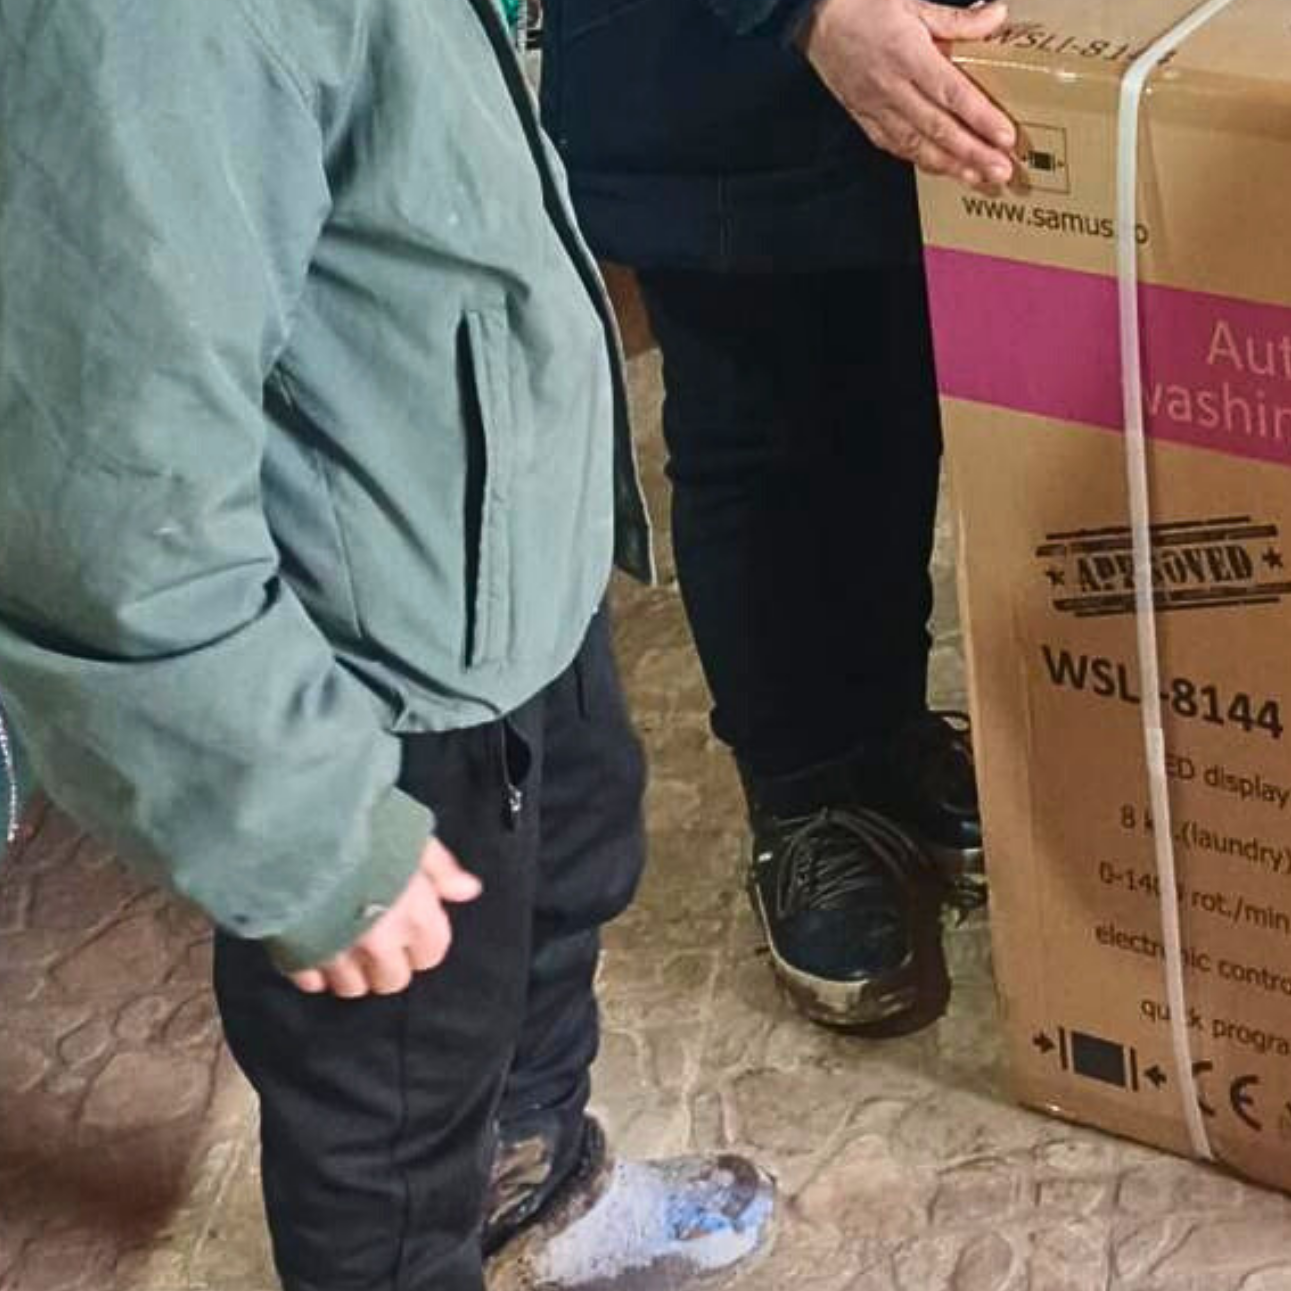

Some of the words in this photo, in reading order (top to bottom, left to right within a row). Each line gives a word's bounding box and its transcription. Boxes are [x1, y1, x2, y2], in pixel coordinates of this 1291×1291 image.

[961, 195, 1149, 245] www.samuso
[1041, 643, 1284, 740] WSL-8144
[1163, 753, 1196, 782] ED
[1203, 764, 1291, 808] display
[1094, 922, 1212, 973] electrnic
[1140, 998, 1204, 1031] quk
